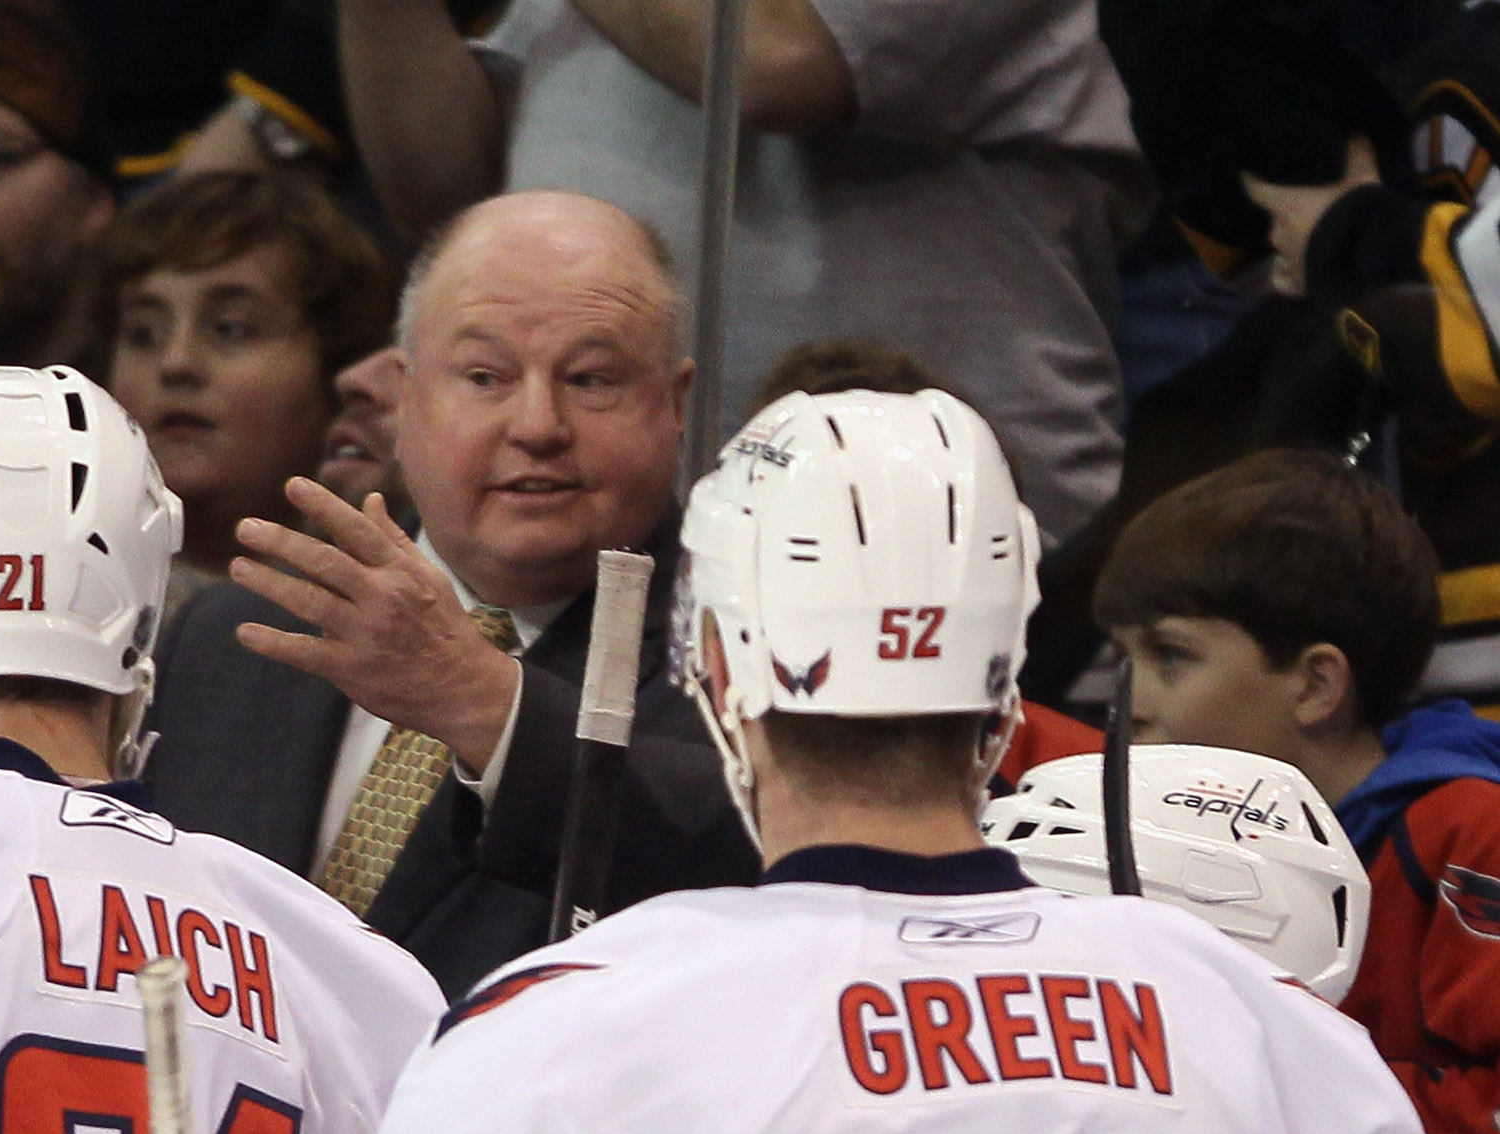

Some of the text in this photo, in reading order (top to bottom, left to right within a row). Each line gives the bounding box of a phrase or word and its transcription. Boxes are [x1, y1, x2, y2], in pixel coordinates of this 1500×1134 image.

[877, 606, 947, 660] 52
[1161, 778, 1289, 842] capitals
[28, 873, 281, 1043] LAICH
[837, 971, 1174, 1097] GREEN
